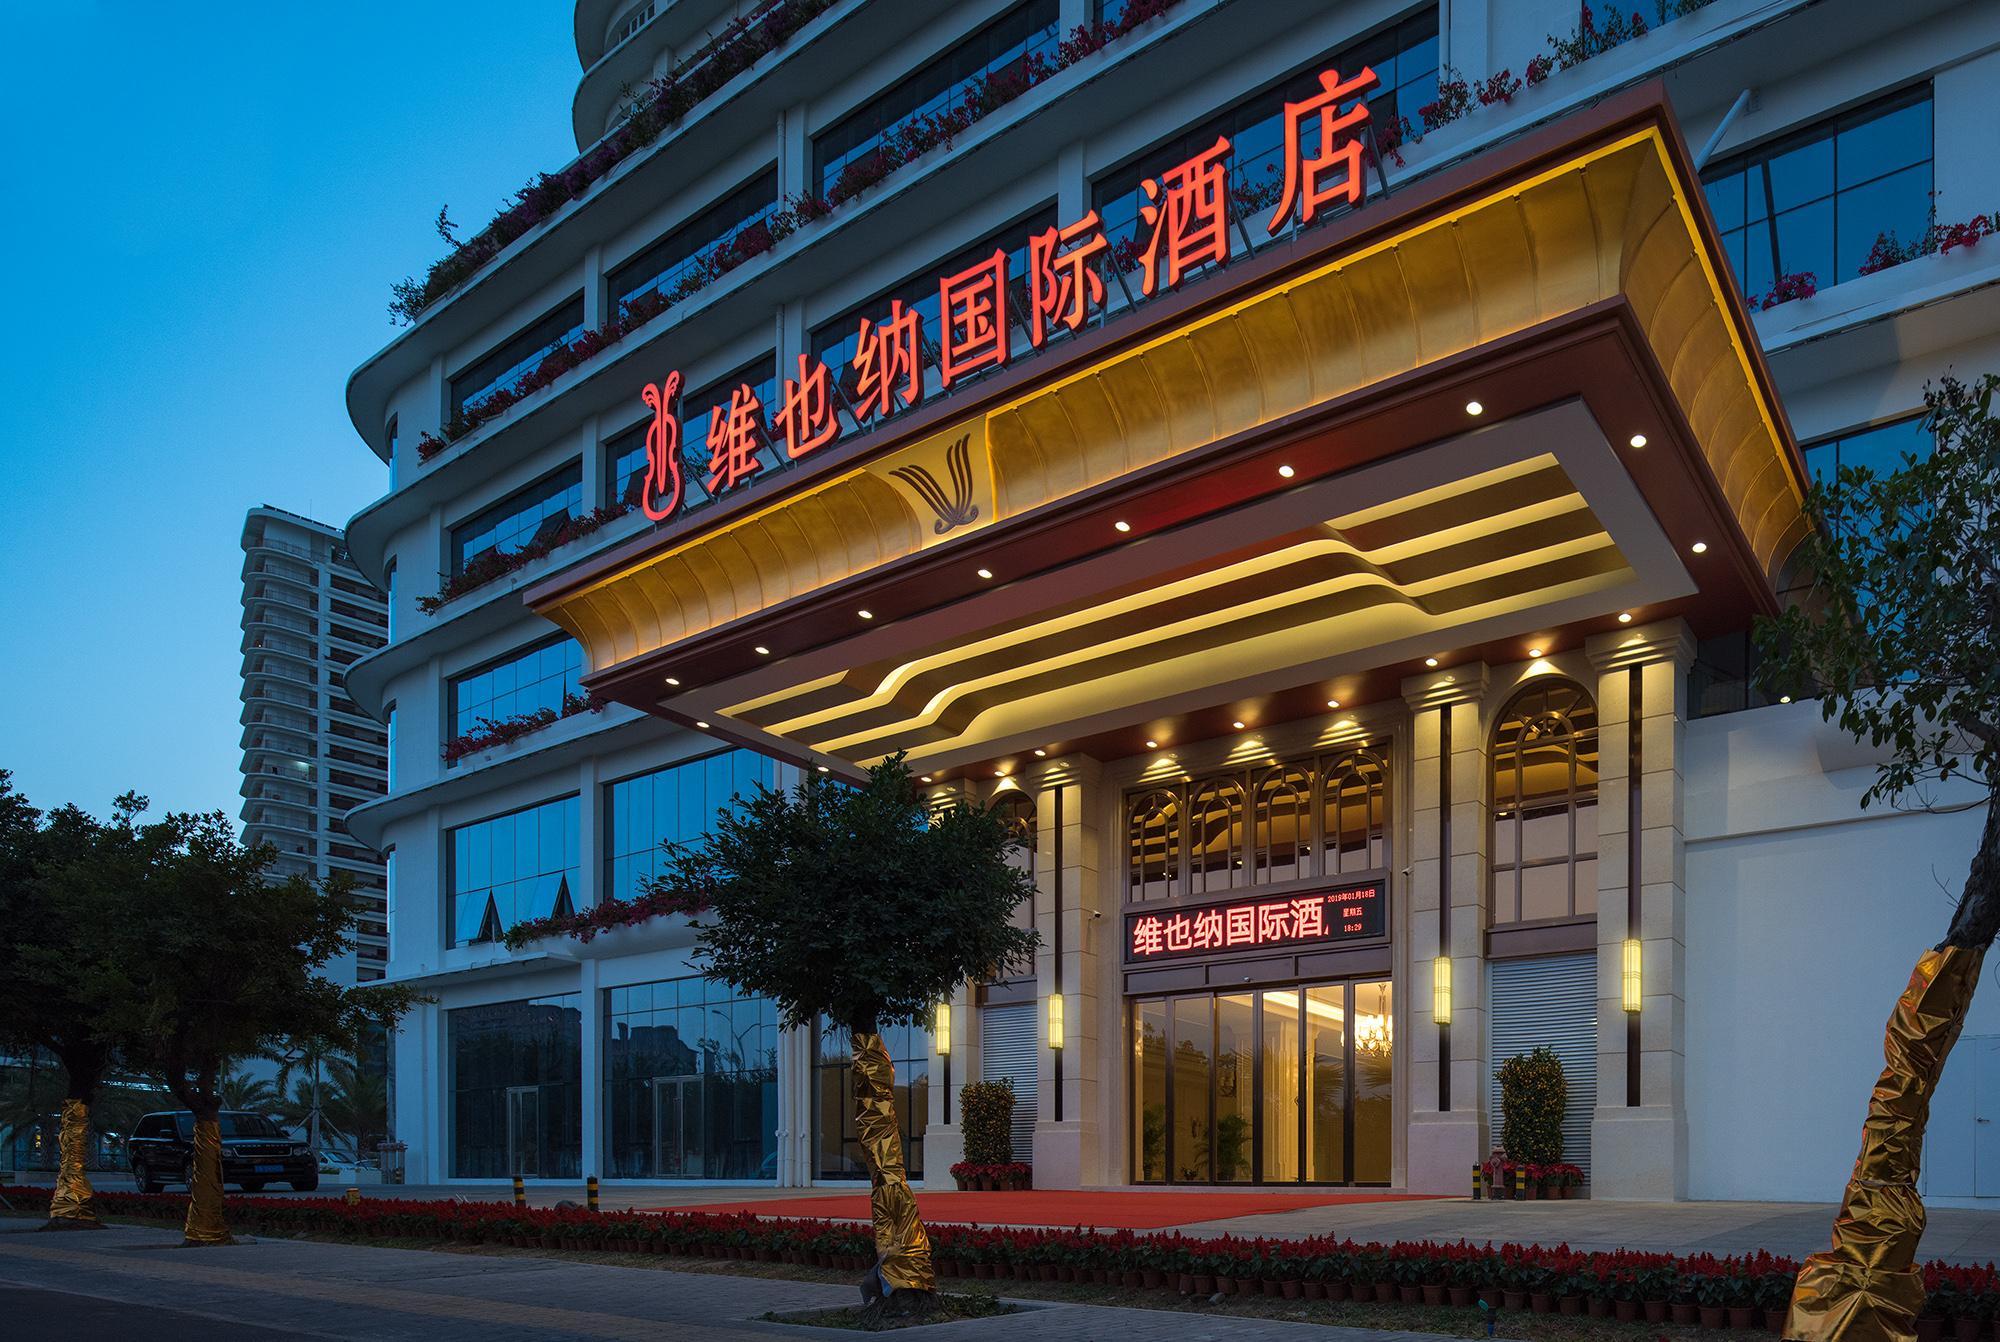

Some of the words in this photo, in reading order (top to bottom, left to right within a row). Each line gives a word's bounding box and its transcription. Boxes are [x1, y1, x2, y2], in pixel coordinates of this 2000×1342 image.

[706, 66, 1379, 493] 维也纳国际酒店
[1133, 897, 1329, 955] 维也纳国际酒
